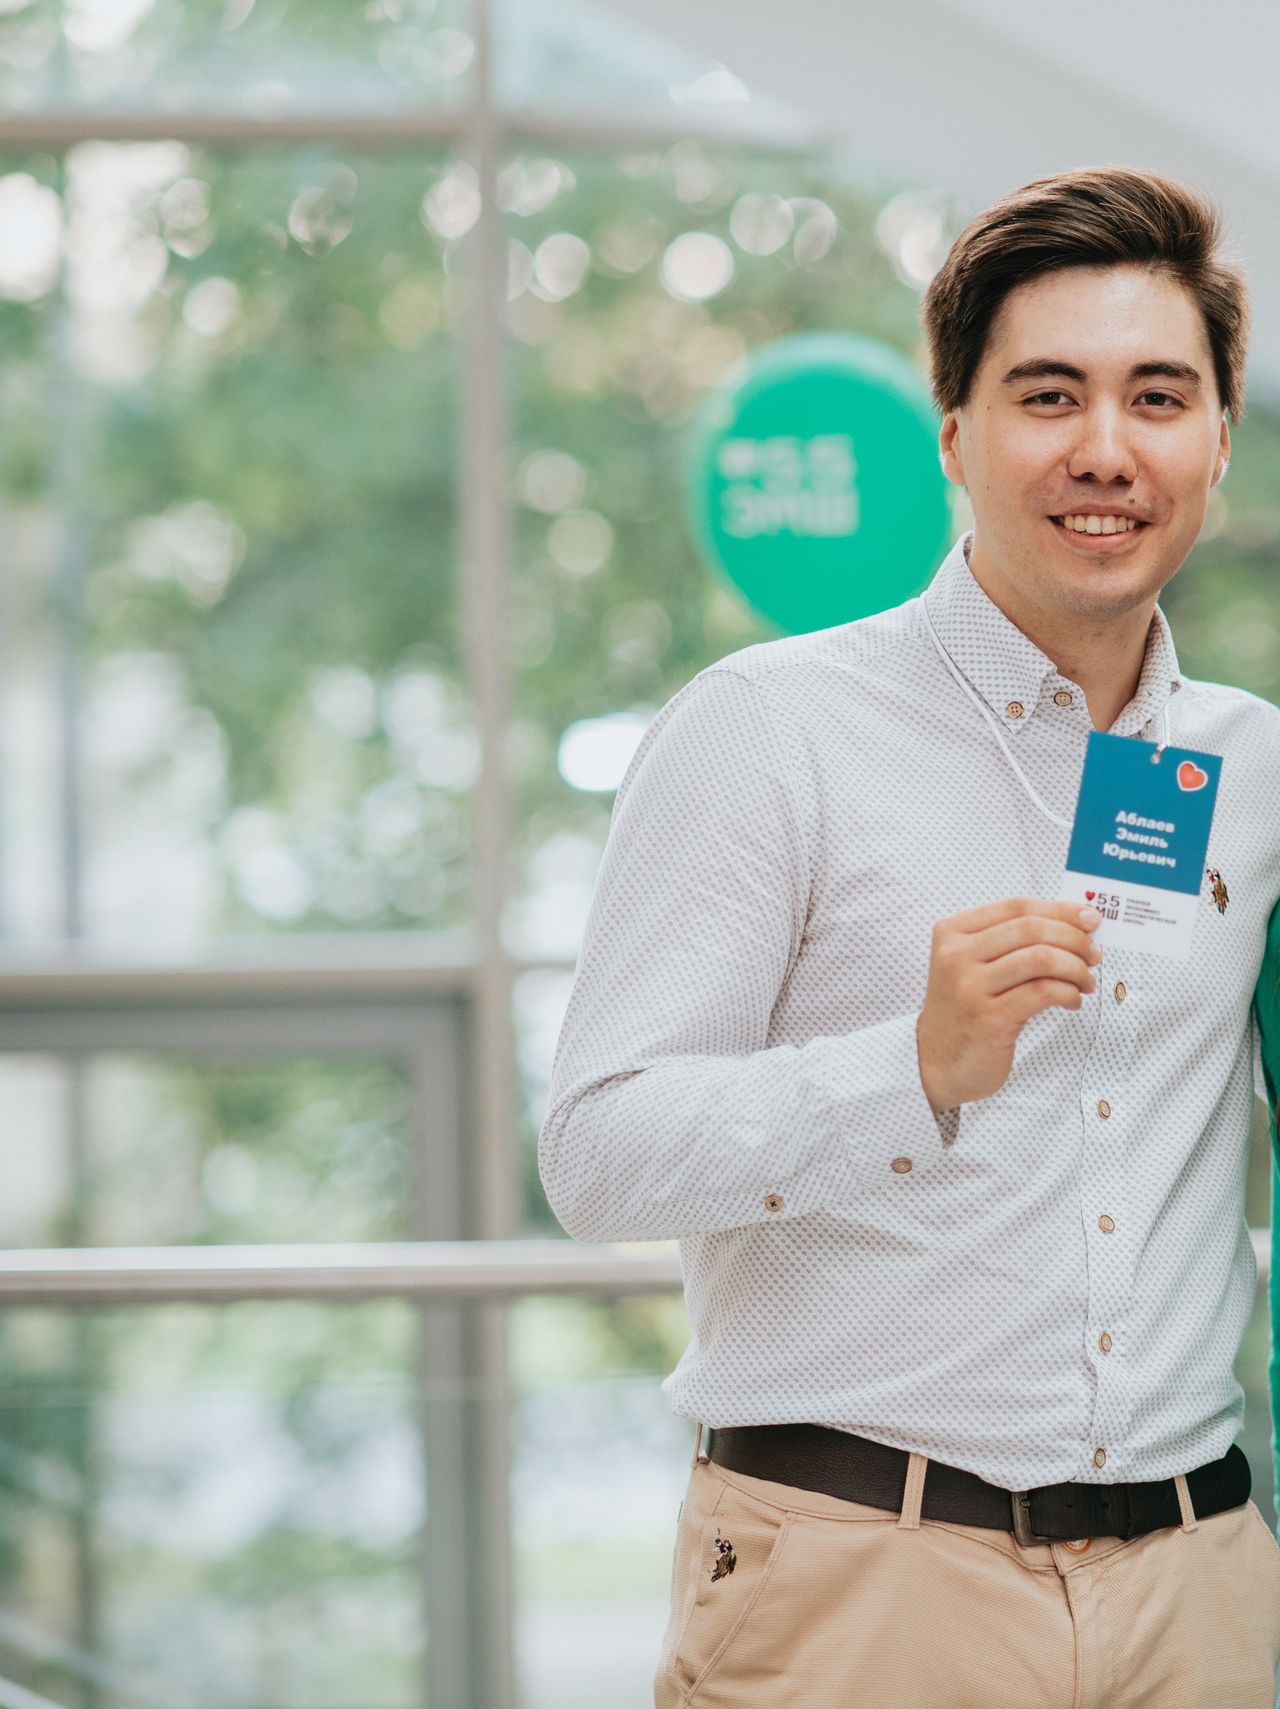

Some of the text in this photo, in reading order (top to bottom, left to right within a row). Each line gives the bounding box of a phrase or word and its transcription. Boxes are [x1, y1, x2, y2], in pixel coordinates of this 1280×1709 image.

[1115, 810, 1175, 833] Аблаев
[1115, 827, 1169, 849] Эмиль
[1102, 842, 1176, 868] Юрьевич
[1097, 893, 1120, 907] 55
[1085, 904, 1119, 920] МШ
